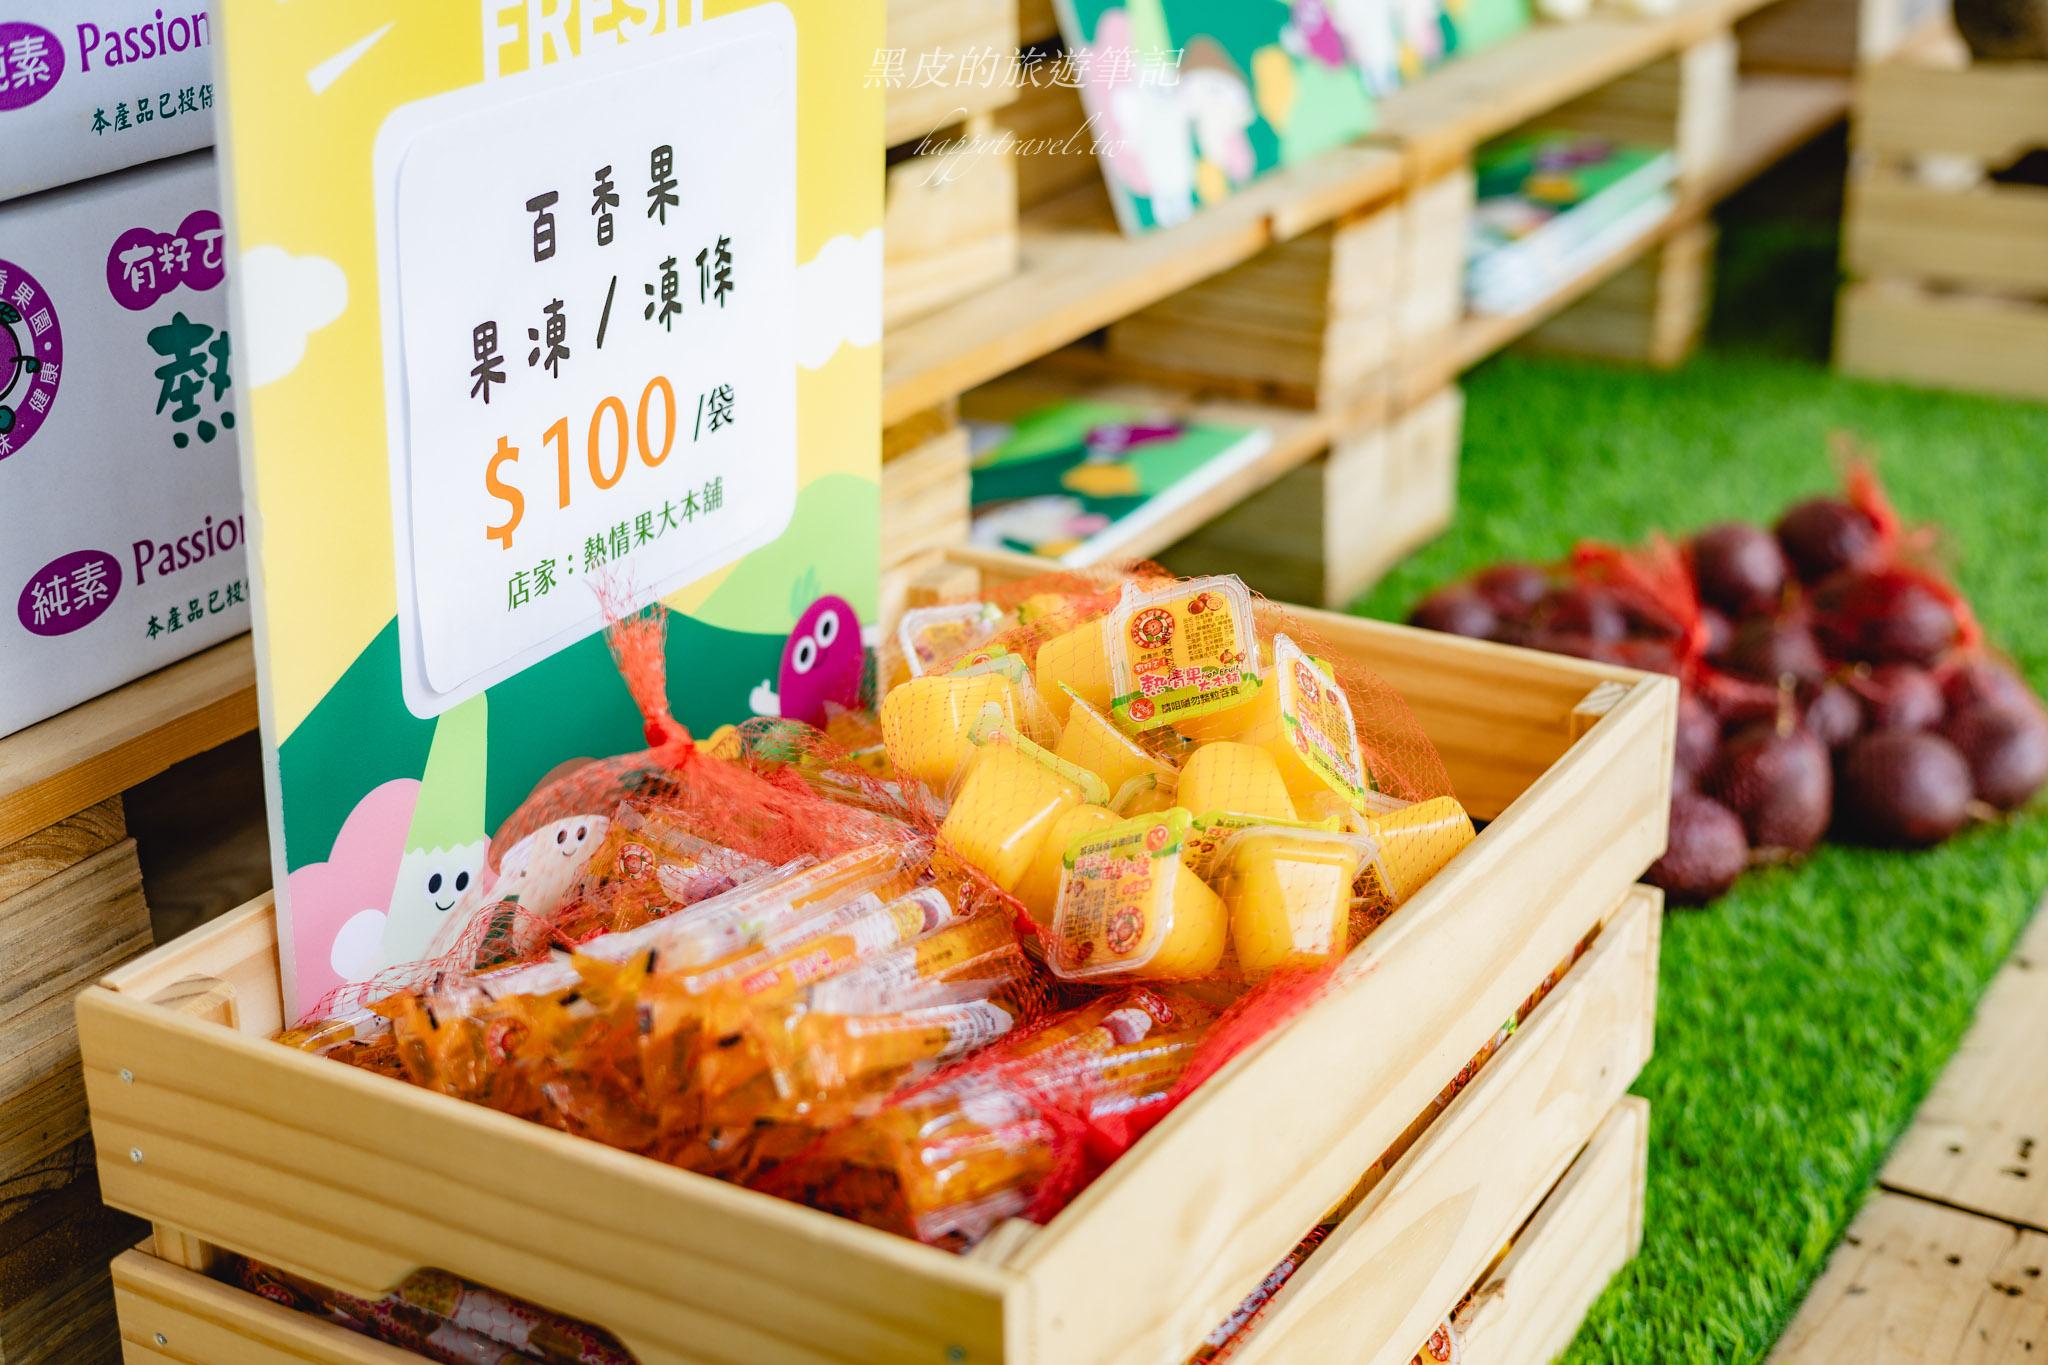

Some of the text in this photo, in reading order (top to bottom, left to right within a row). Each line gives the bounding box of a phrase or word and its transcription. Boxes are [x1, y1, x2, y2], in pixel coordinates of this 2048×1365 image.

[525, 144, 680, 263] 百香果
[31, 560, 109, 626] 純素
[146, 577, 249, 640] 本產品已投
